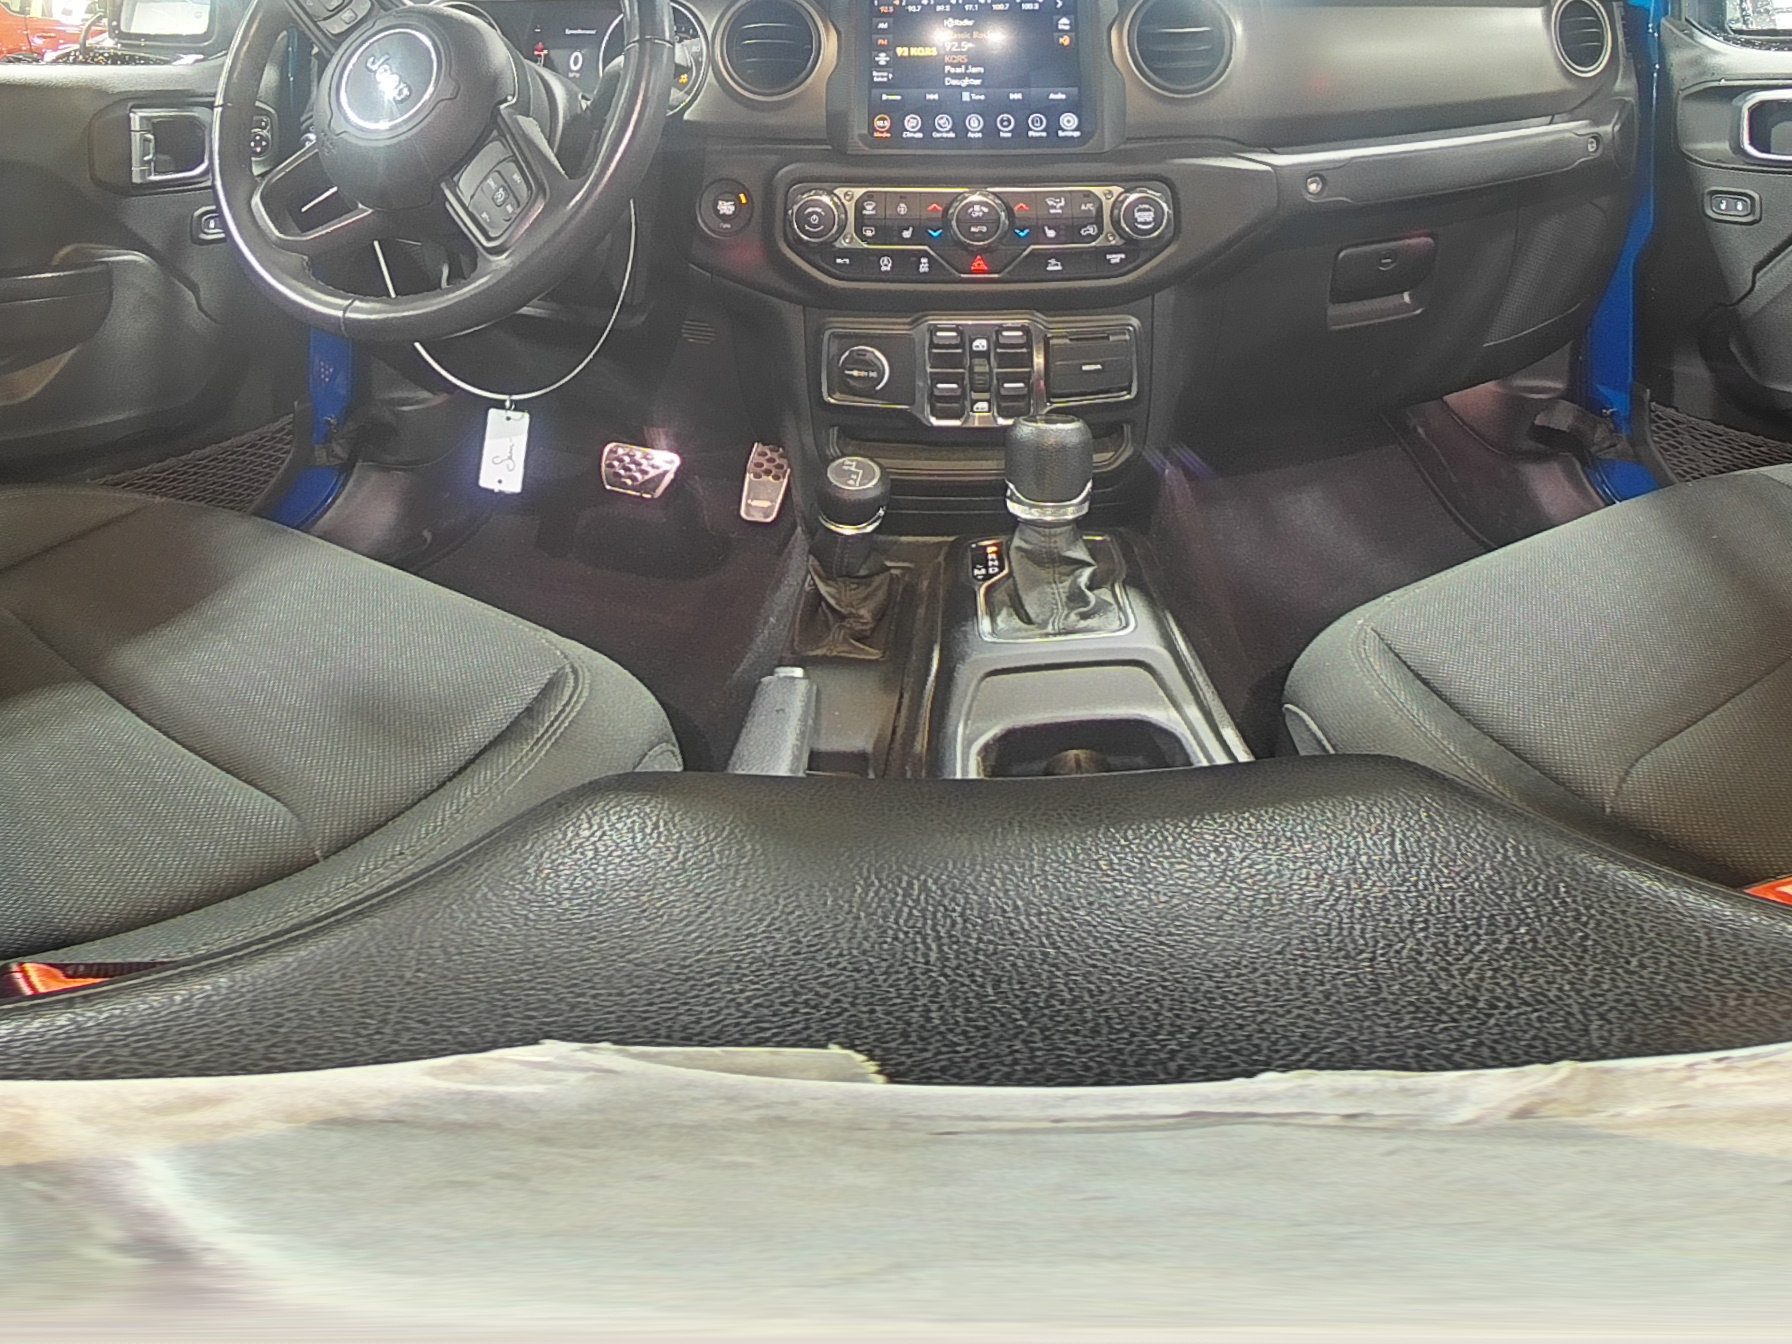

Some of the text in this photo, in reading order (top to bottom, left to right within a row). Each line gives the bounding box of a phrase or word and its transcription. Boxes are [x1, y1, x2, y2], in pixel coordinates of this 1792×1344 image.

[945, 41, 968, 52] 92.5
[569, 51, 583, 71] 0
[945, 65, 984, 74] Pearl Jam
[366, 55, 410, 101] Jeep
[945, 77, 982, 87] Daughter
